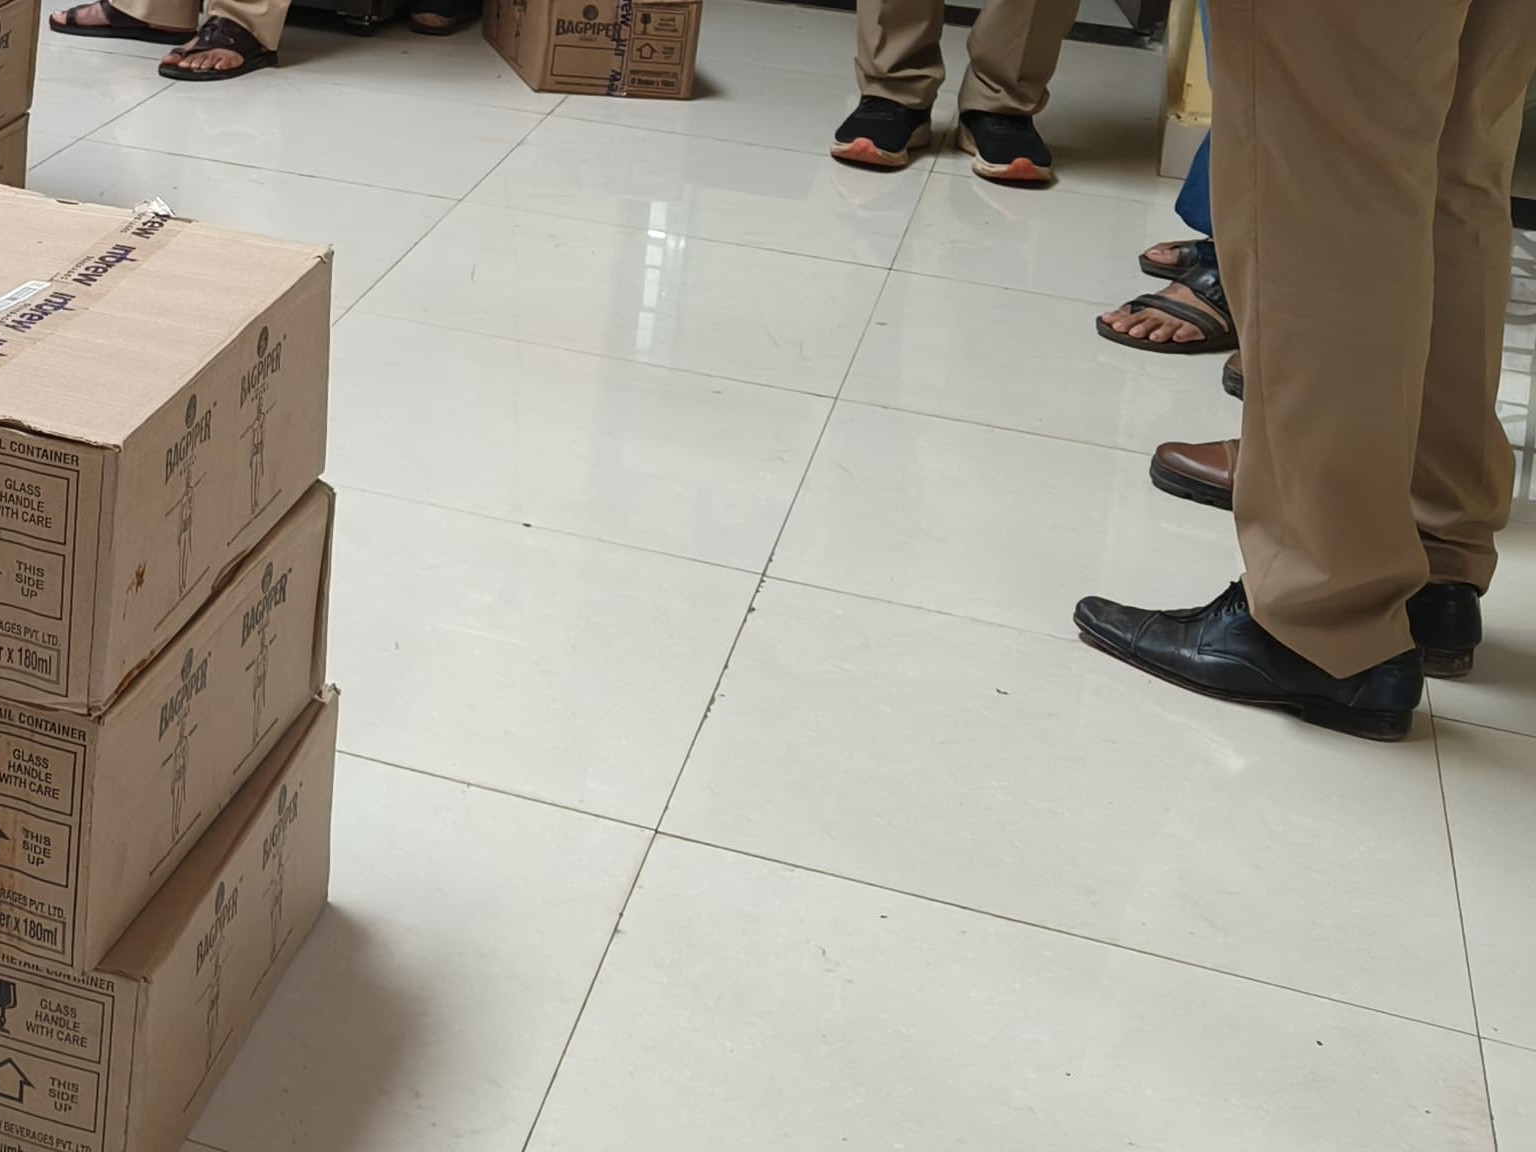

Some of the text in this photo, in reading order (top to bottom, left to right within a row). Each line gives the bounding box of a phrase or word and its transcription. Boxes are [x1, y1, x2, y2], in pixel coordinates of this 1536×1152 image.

[240, 349, 282, 409] BAGPIPER
[9, 441, 79, 467] CONTAINER
[164, 409, 212, 487] BAGPIPER
[4, 478, 41, 498] GLASS
[0, 491, 44, 513] HANDLE
[21, 511, 52, 529] CARE
[16, 560, 45, 578] THIS
[15, 573, 44, 590] SIDE
[21, 586, 38, 599] UP
[240, 572, 288, 647] BAGPIPER
[17, 647, 52, 675] 180ml
[158, 658, 208, 742] BAGPIPER
[18, 712, 86, 742] CONTAINER
[13, 748, 49, 770] GLASS
[8, 760, 52, 784] HANDLE
[0, 771, 60, 800] WITH CARE
[22, 827, 51, 846] THIS
[261, 792, 300, 872] BAGPIPER
[22, 840, 51, 859] SIDE
[27, 853, 45, 866] UP
[23, 918, 58, 946] 180ml
[195, 888, 239, 978] BAGPIPER
[40, 998, 77, 1019] GLASS
[35, 1010, 80, 1033] HANDLE
[26, 1020, 87, 1048] WITH CARE
[48, 1085, 78, 1104] SIDE
[49, 1076, 79, 1093] THIS
[54, 1101, 72, 1112] UP
